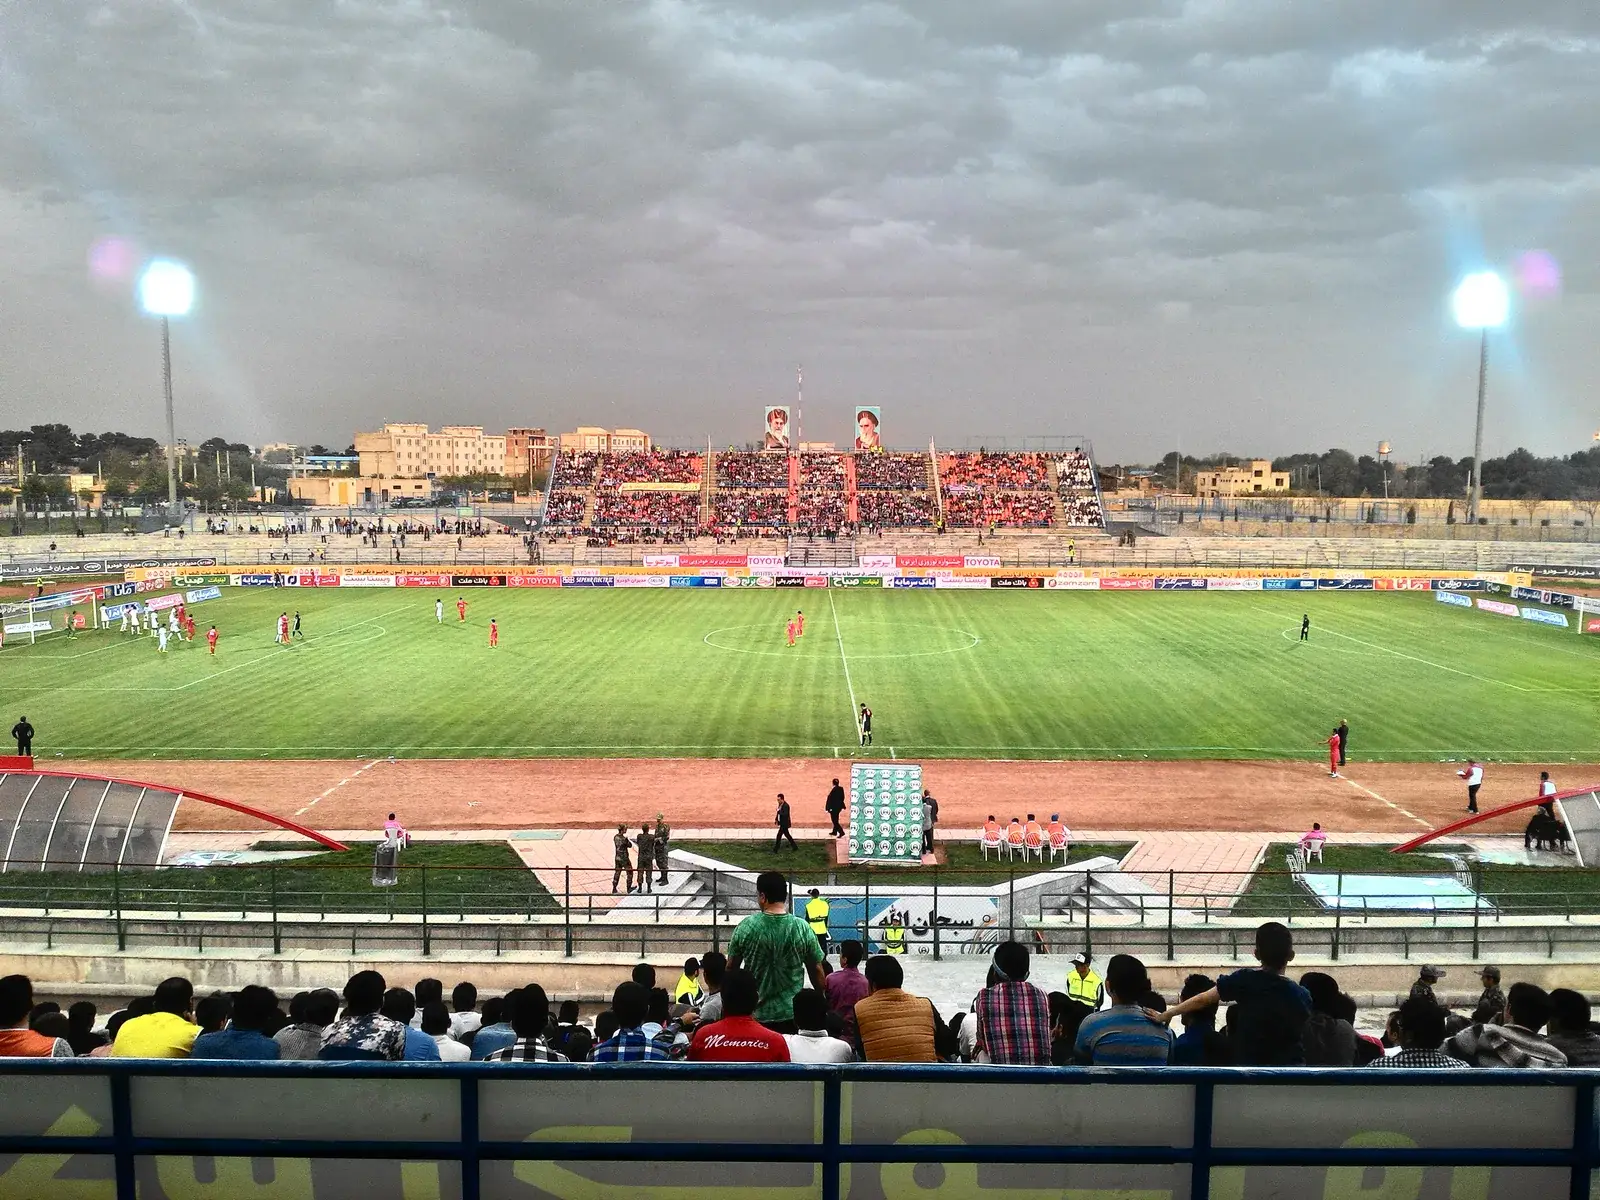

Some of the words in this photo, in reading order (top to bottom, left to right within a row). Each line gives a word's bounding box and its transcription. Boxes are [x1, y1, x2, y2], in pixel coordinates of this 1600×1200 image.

[749, 557, 783, 565] TOYOTA
[965, 558, 1000, 566] TOYOTA
[174, 576, 205, 587] صباح
[458, 577, 473, 585] ملت
[473, 577, 488, 585] بانک
[526, 577, 558, 585] TOYOTA
[833, 577, 860, 588] صباح
[917, 577, 935, 586] بانک
[1012, 579, 1027, 587] بانک
[878, 905, 910, 928] الله
[910, 909, 974, 936] سبحان
[704, 1033, 770, 1050] Memories
